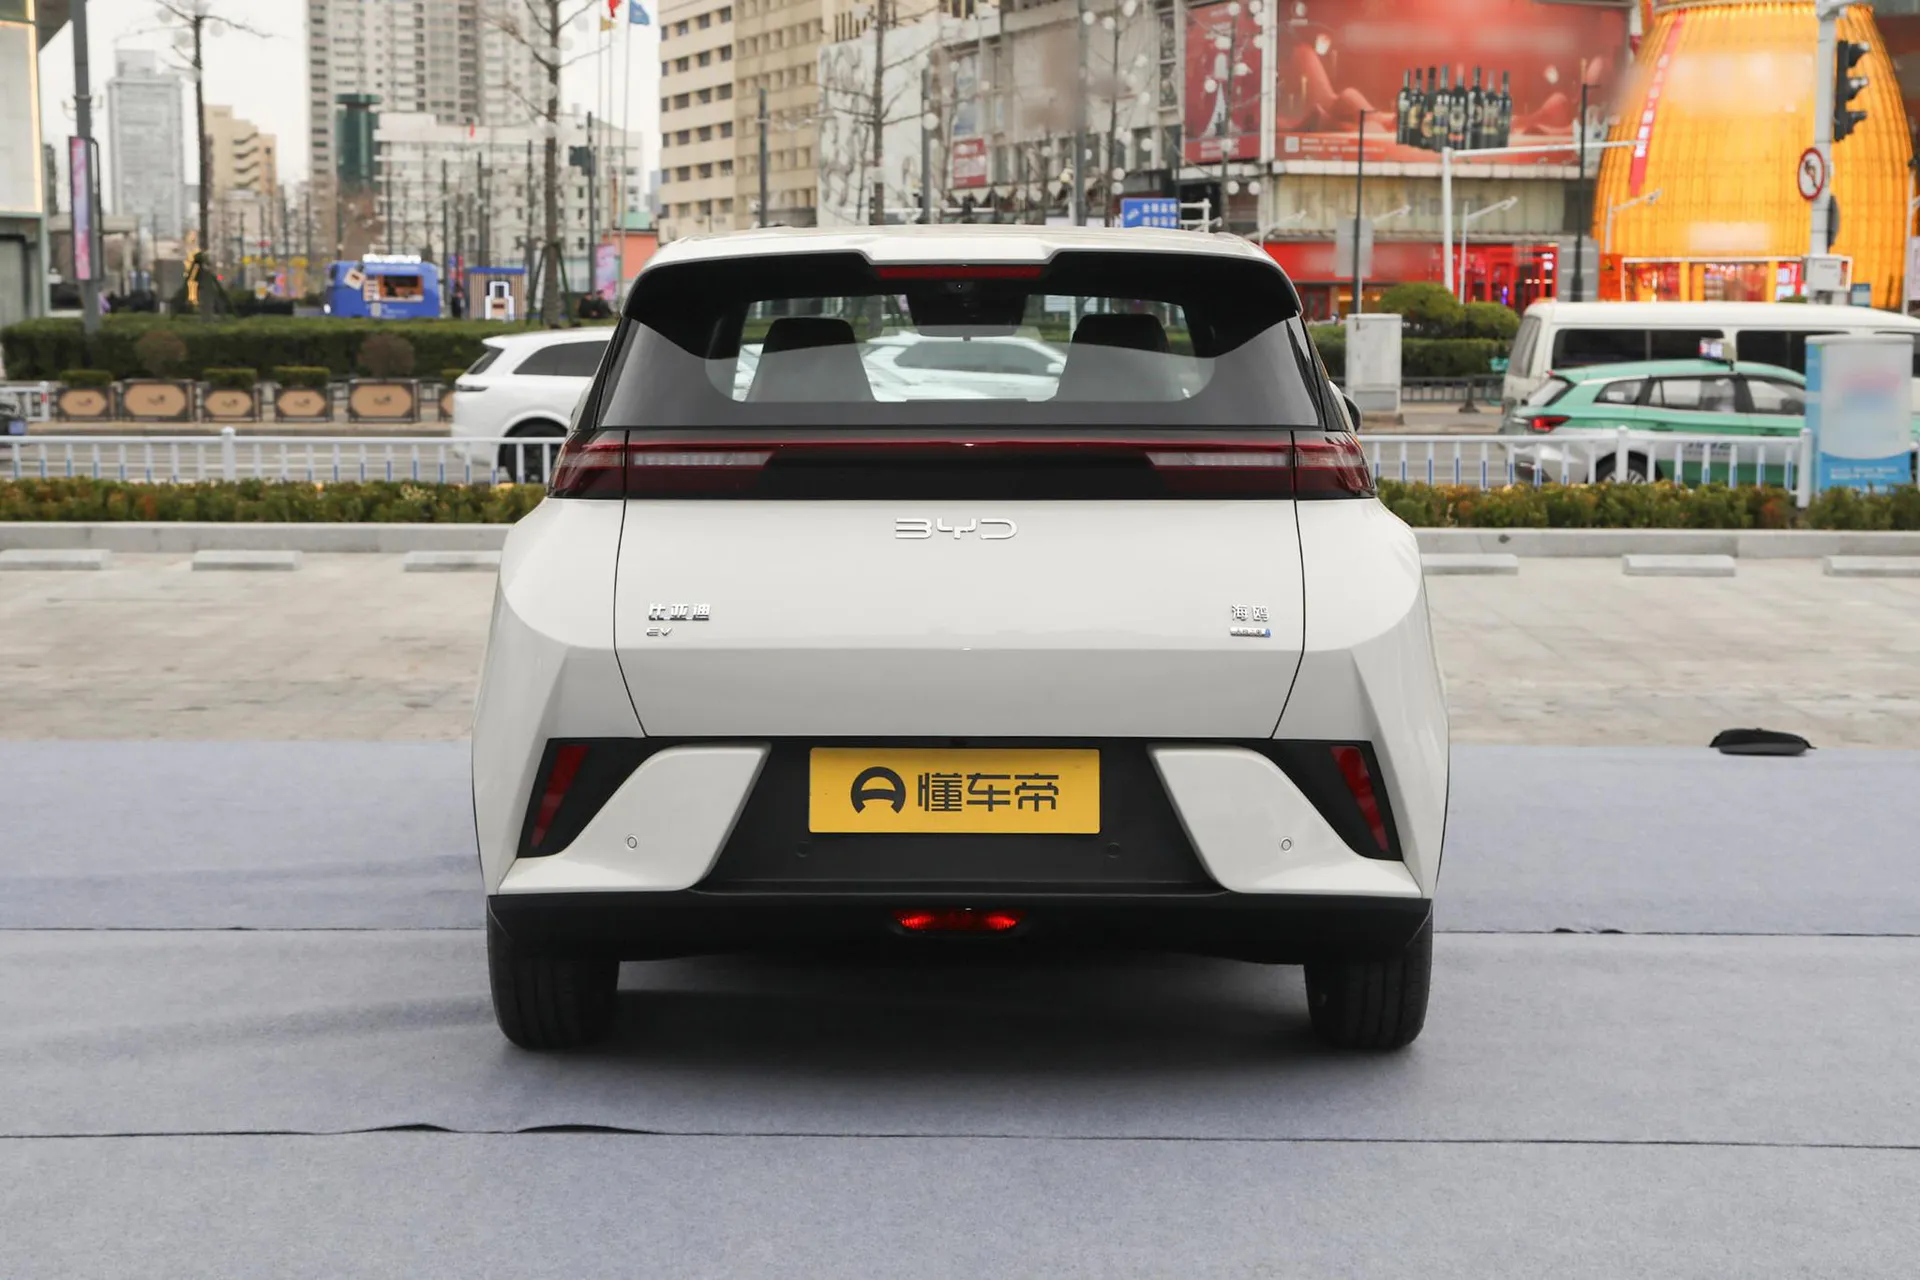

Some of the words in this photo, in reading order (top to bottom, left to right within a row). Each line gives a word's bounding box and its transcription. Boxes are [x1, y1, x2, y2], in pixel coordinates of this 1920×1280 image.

[895, 517, 1017, 540] BYD
[648, 603, 710, 621] 比亚迪
[1231, 603, 1270, 622] 海鸥
[646, 627, 672, 637] EV
[917, 772, 1060, 813] 懂车帝
